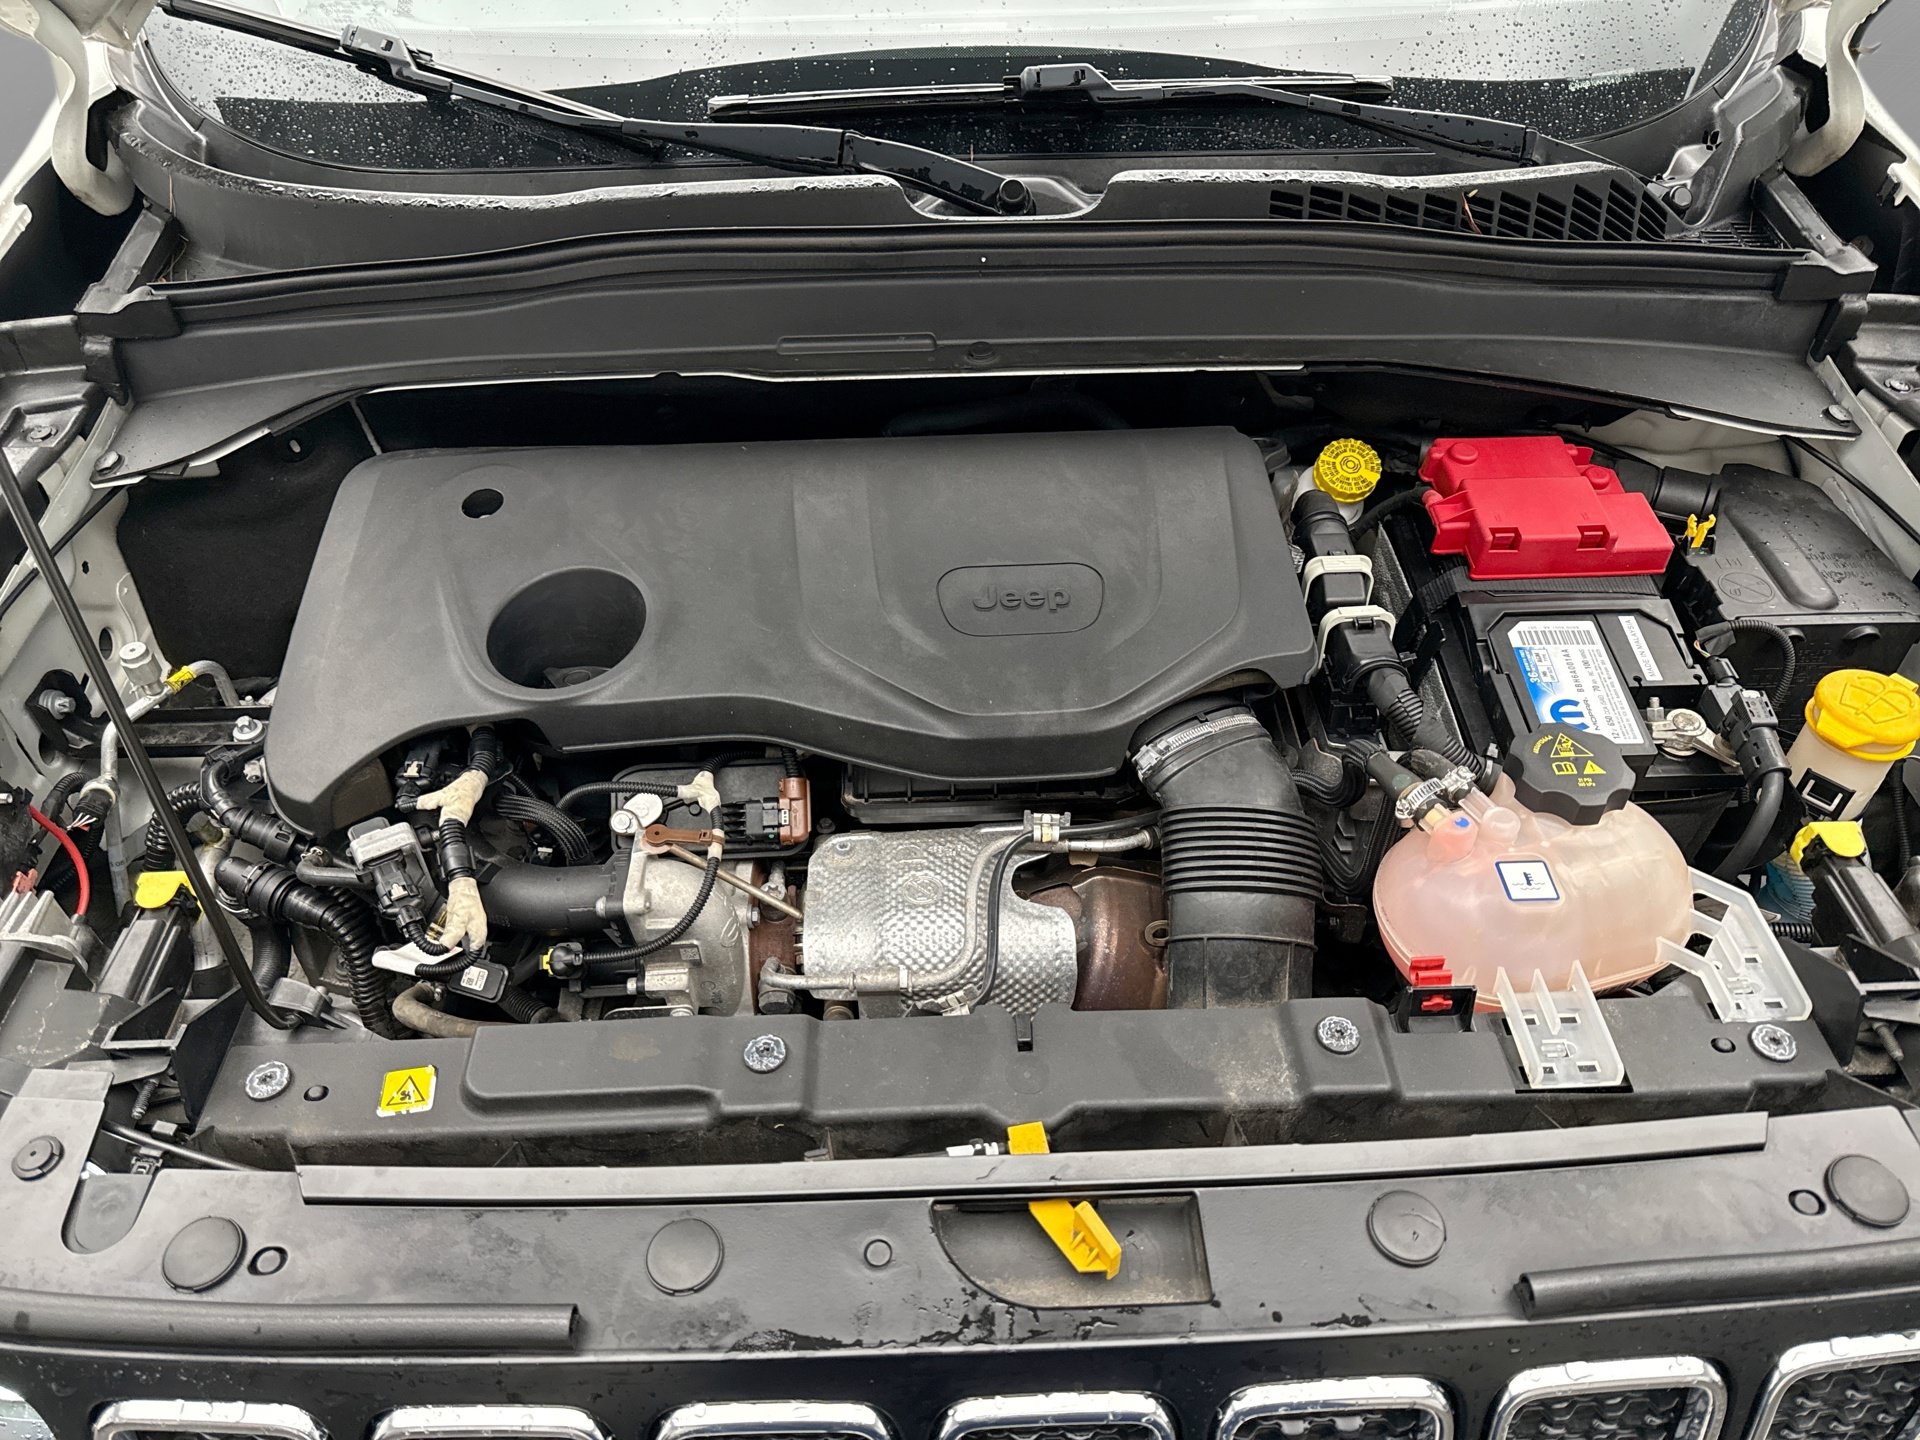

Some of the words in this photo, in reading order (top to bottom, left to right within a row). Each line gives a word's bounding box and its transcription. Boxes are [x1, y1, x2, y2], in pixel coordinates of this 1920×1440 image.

[972, 584, 1071, 613] Jeep
[1627, 619, 1644, 649] MALAYSIA
[1580, 659, 1592, 669] 100
[1642, 658, 1655, 677] MADE
[1527, 671, 1541, 683] 36
[1590, 684, 1601, 692] 70
[1603, 715, 1616, 726] 650
